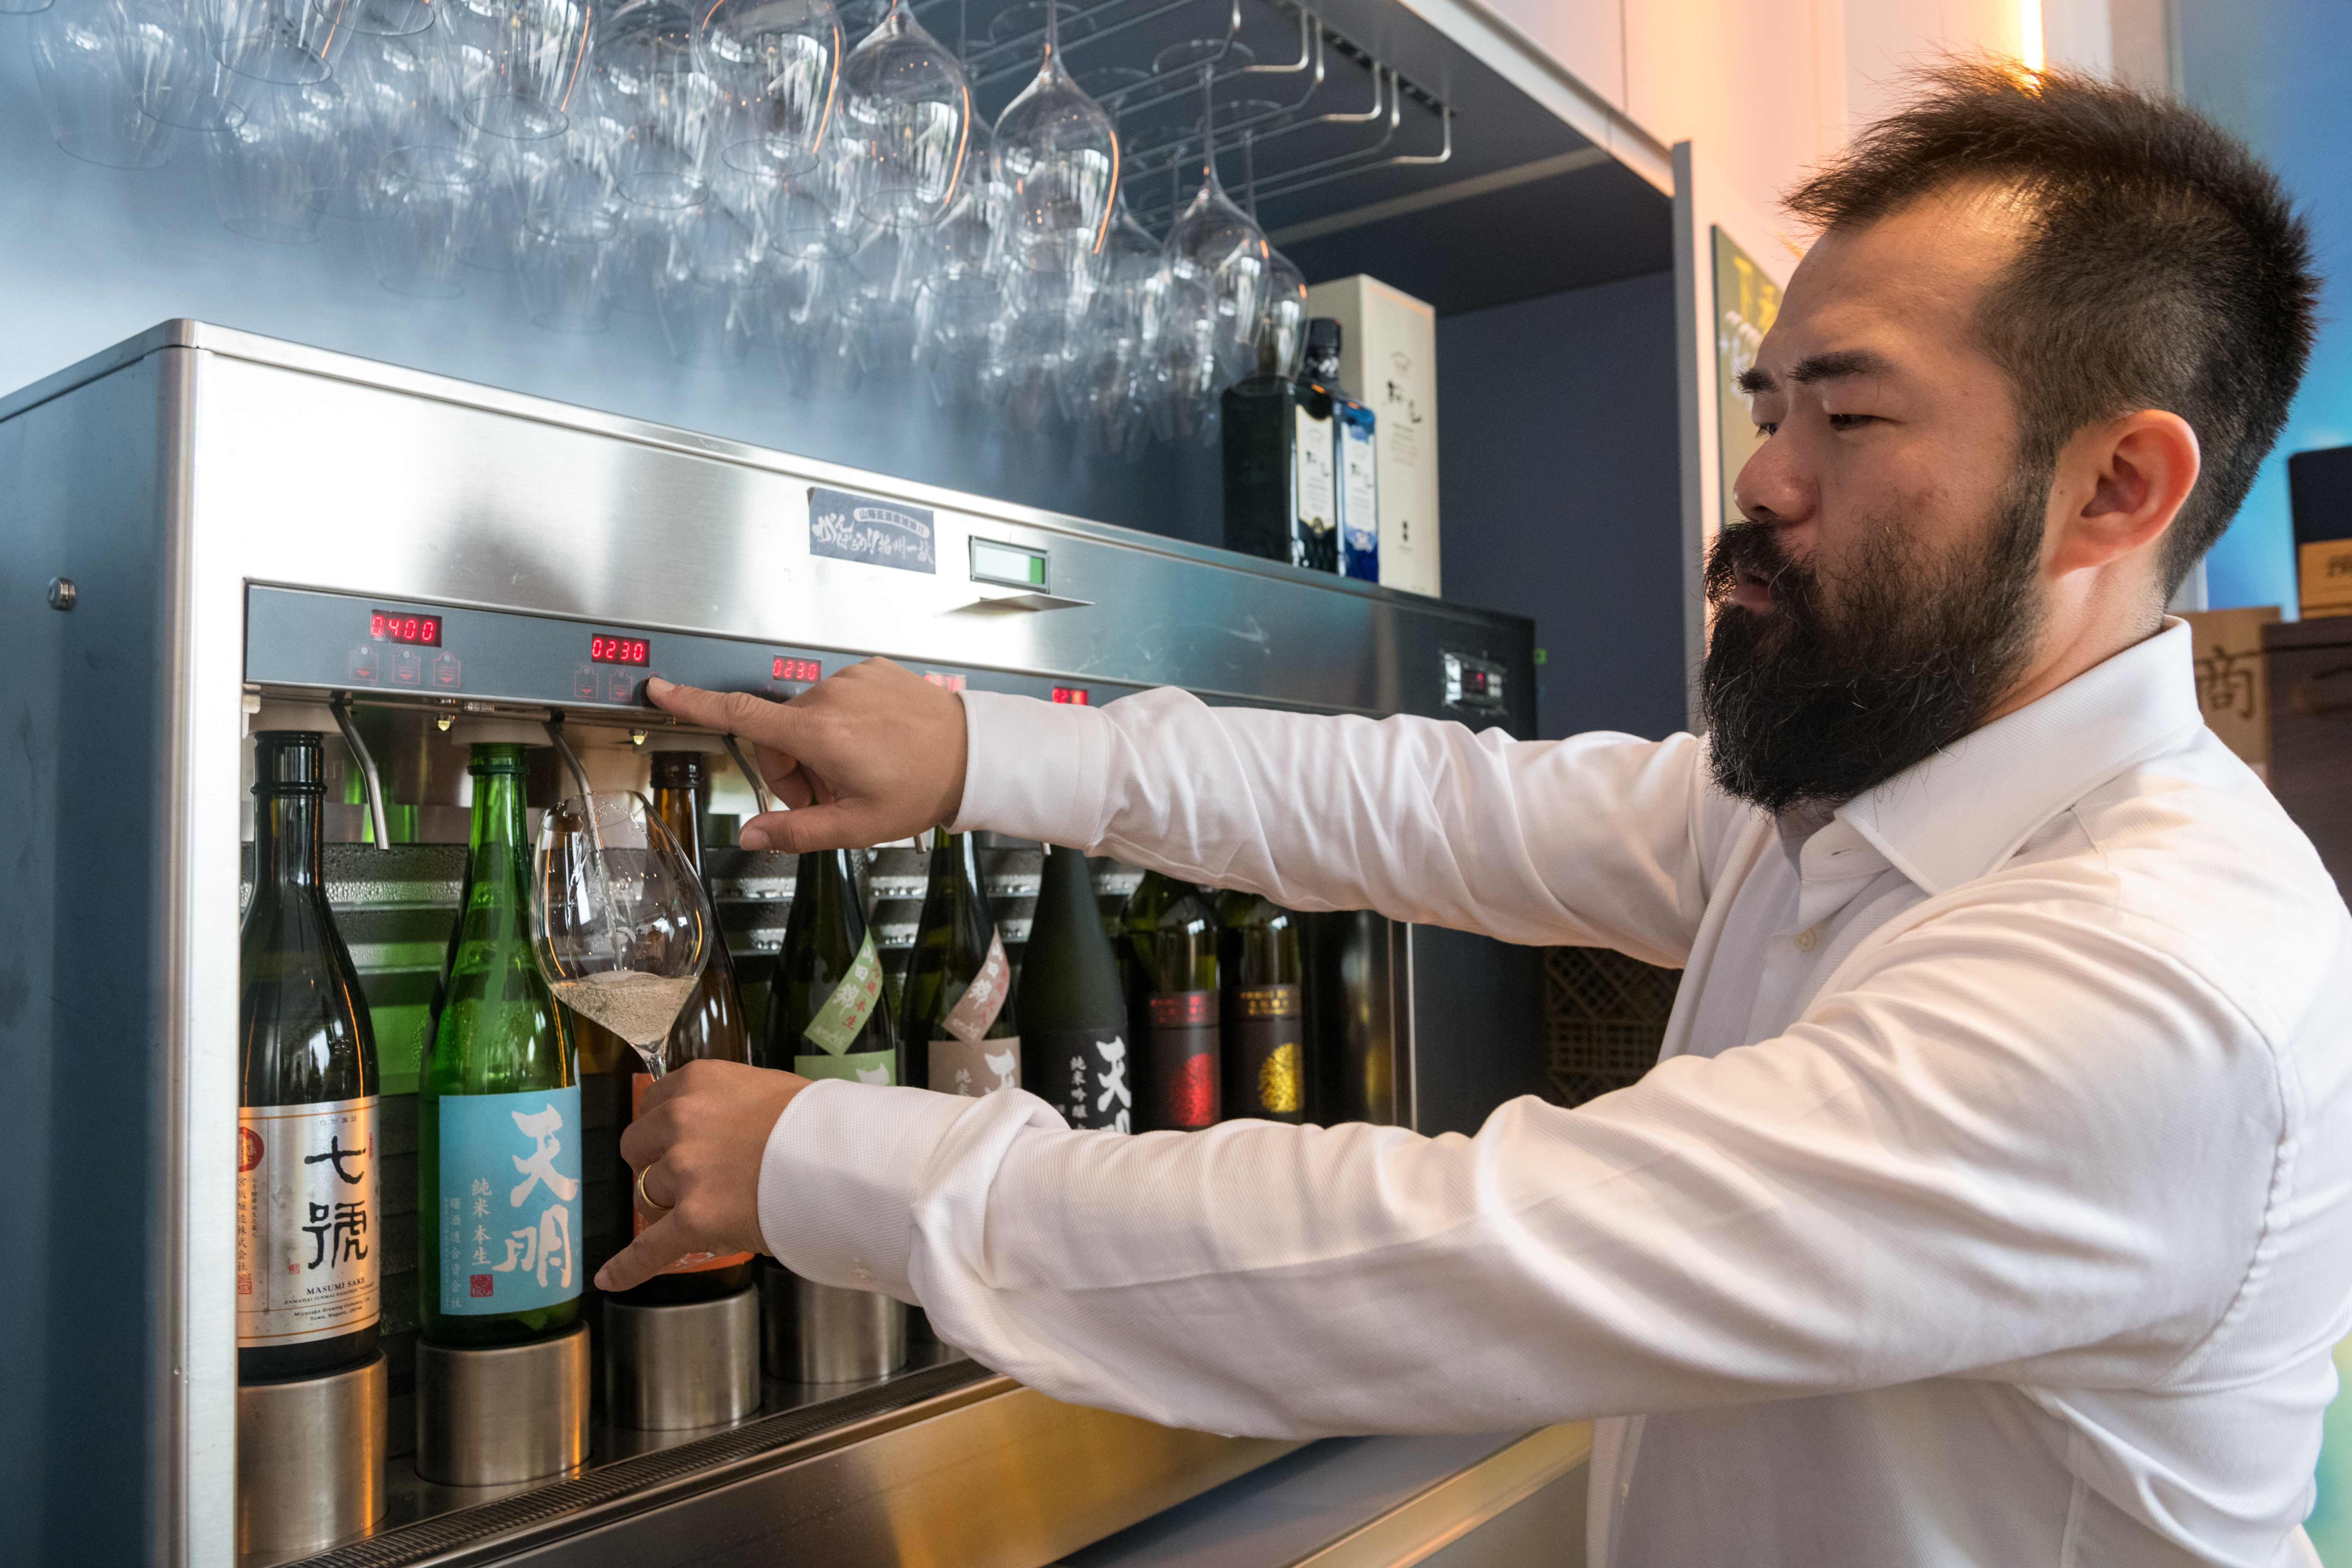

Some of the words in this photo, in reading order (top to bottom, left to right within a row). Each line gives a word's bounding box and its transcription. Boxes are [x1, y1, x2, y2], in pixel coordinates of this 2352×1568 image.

[371, 615, 435, 641] 0400
[591, 639, 645, 662] 0230
[773, 659, 817, 681] 0230
[1070, 1055, 1088, 1130] 純米吟醸
[471, 1178, 492, 1266] 純米本生
[306, 1282, 345, 1295] MASUMI
[347, 1277, 365, 1287] SAKE
